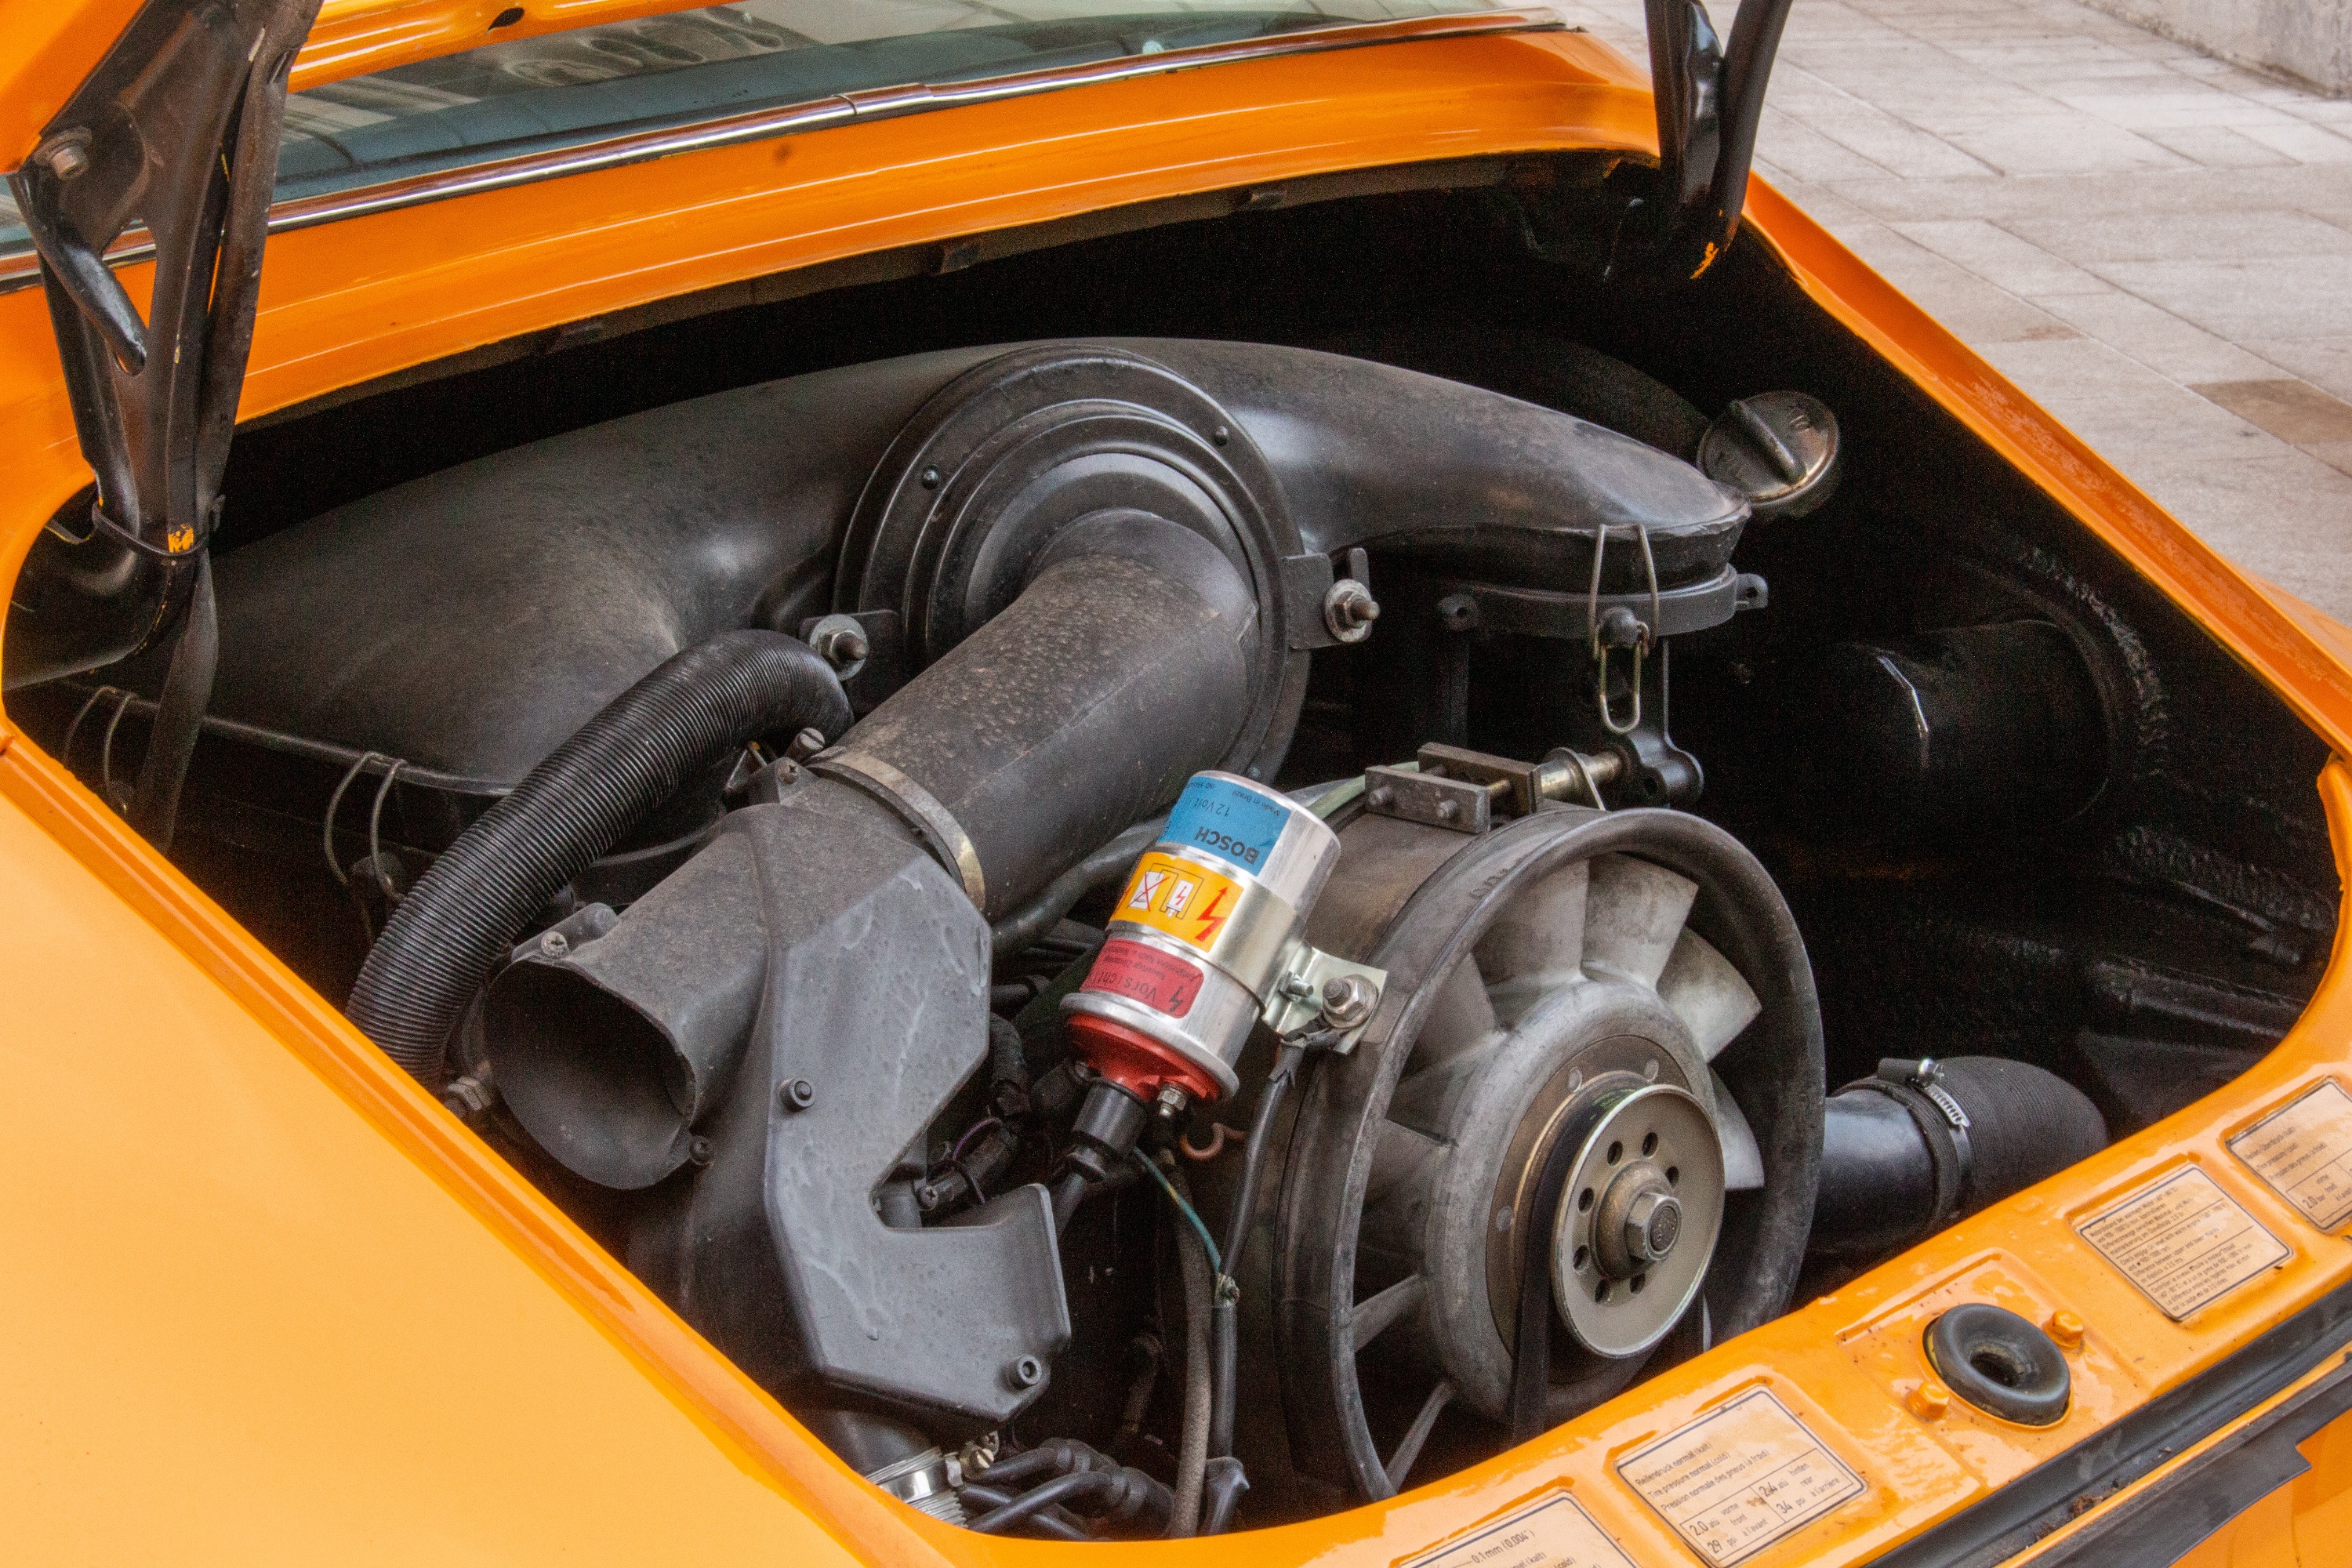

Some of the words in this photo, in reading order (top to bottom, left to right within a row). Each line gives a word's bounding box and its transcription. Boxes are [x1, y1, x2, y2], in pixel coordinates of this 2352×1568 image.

[1232, 790, 1252, 803] Brazil
[1216, 804, 1230, 816] 12
[1261, 802, 1280, 816] Made
[1195, 826, 1258, 864] BOSCH
[2303, 1196, 2318, 1209] 2.0
[1672, 1450, 1696, 1467] normal
[1647, 1489, 1664, 1497] Tire
[1662, 1475, 1690, 1494] pressure
[1689, 1461, 1713, 1477] normal
[1710, 1451, 1730, 1465] (cold)
[1788, 1463, 1809, 1476] hinten
[1800, 1476, 1813, 1486] rear
[1661, 1494, 1690, 1512] Pression
[1689, 1480, 1715, 1497] normale
[1715, 1474, 1727, 1483] des
[1726, 1464, 1746, 1479] pneus
[1759, 1482, 1778, 1497] 2.4
[1720, 1503, 1740, 1515] vorne
[1776, 1501, 1793, 1514] 34
[1730, 1514, 1748, 1526] front
[1690, 1521, 1709, 1536] 2.0
[1707, 1540, 1722, 1554] 29
